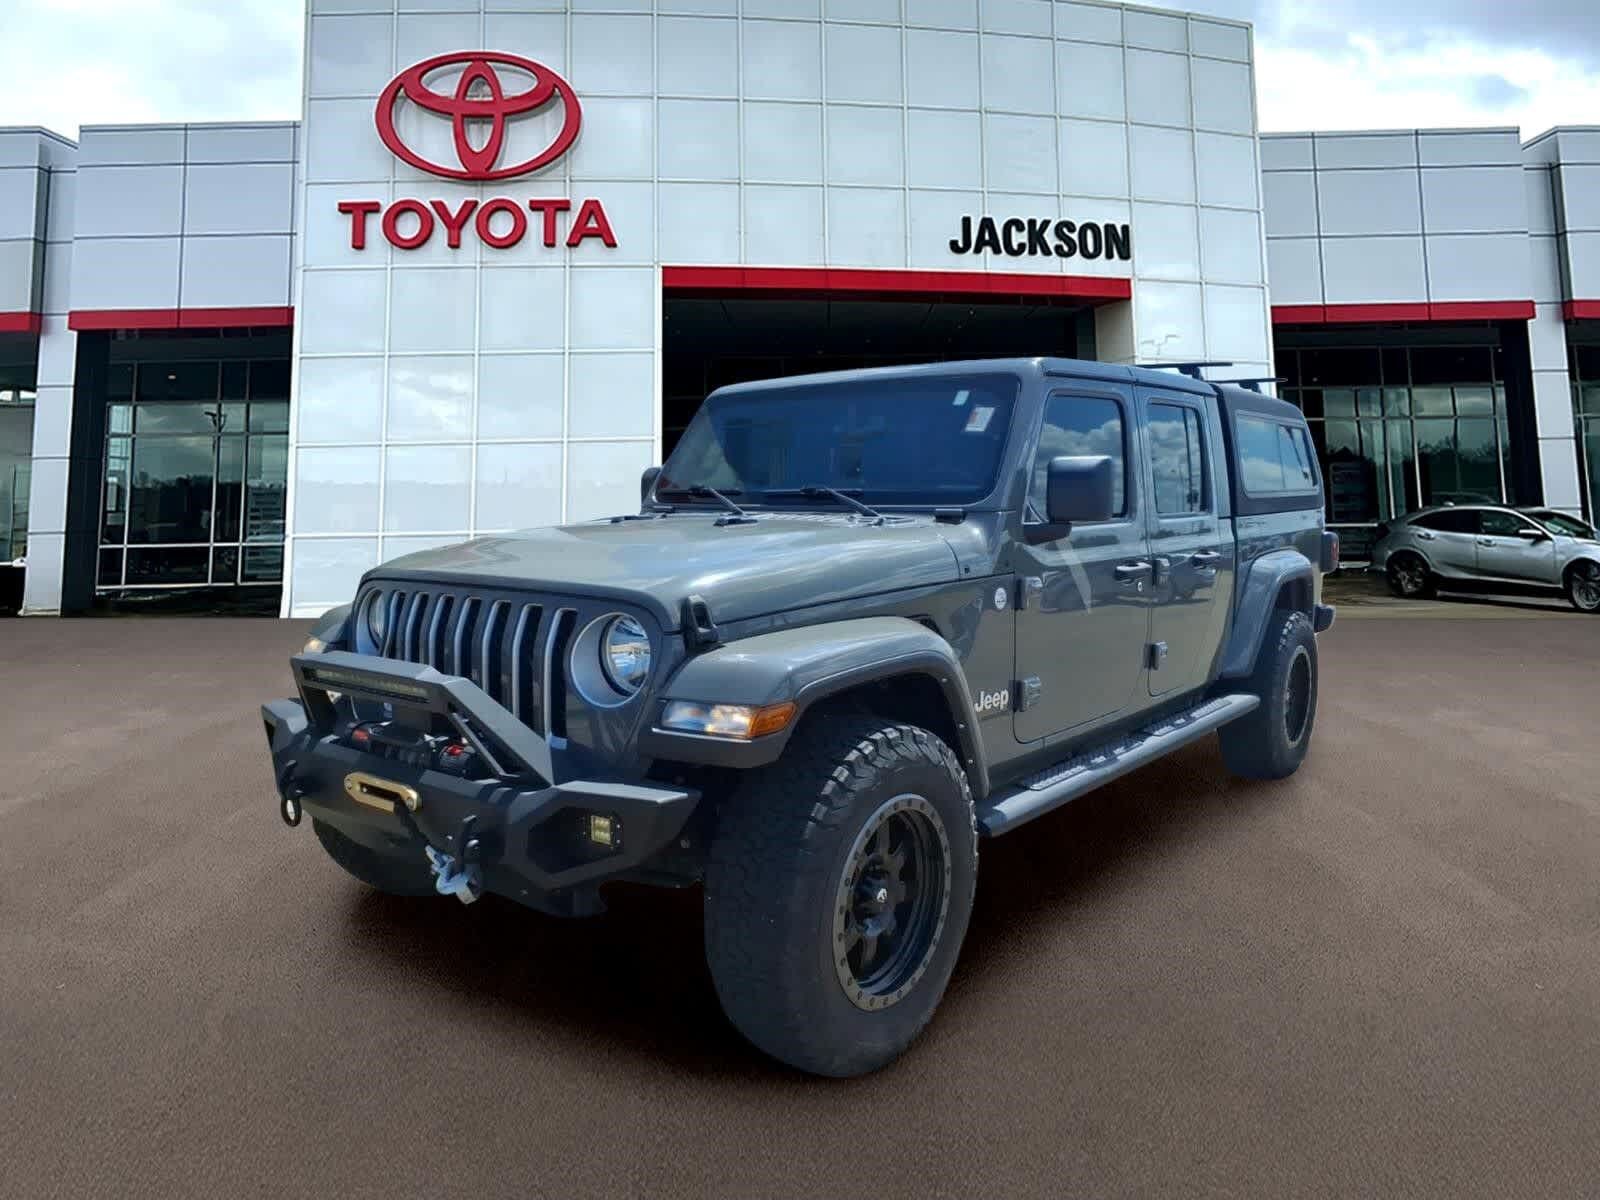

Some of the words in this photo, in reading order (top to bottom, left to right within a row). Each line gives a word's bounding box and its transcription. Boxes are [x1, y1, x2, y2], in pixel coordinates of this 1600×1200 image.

[338, 198, 617, 250] TOYOTA
[949, 216, 1131, 260] JACKSON
[974, 689, 1009, 712] Jeep
